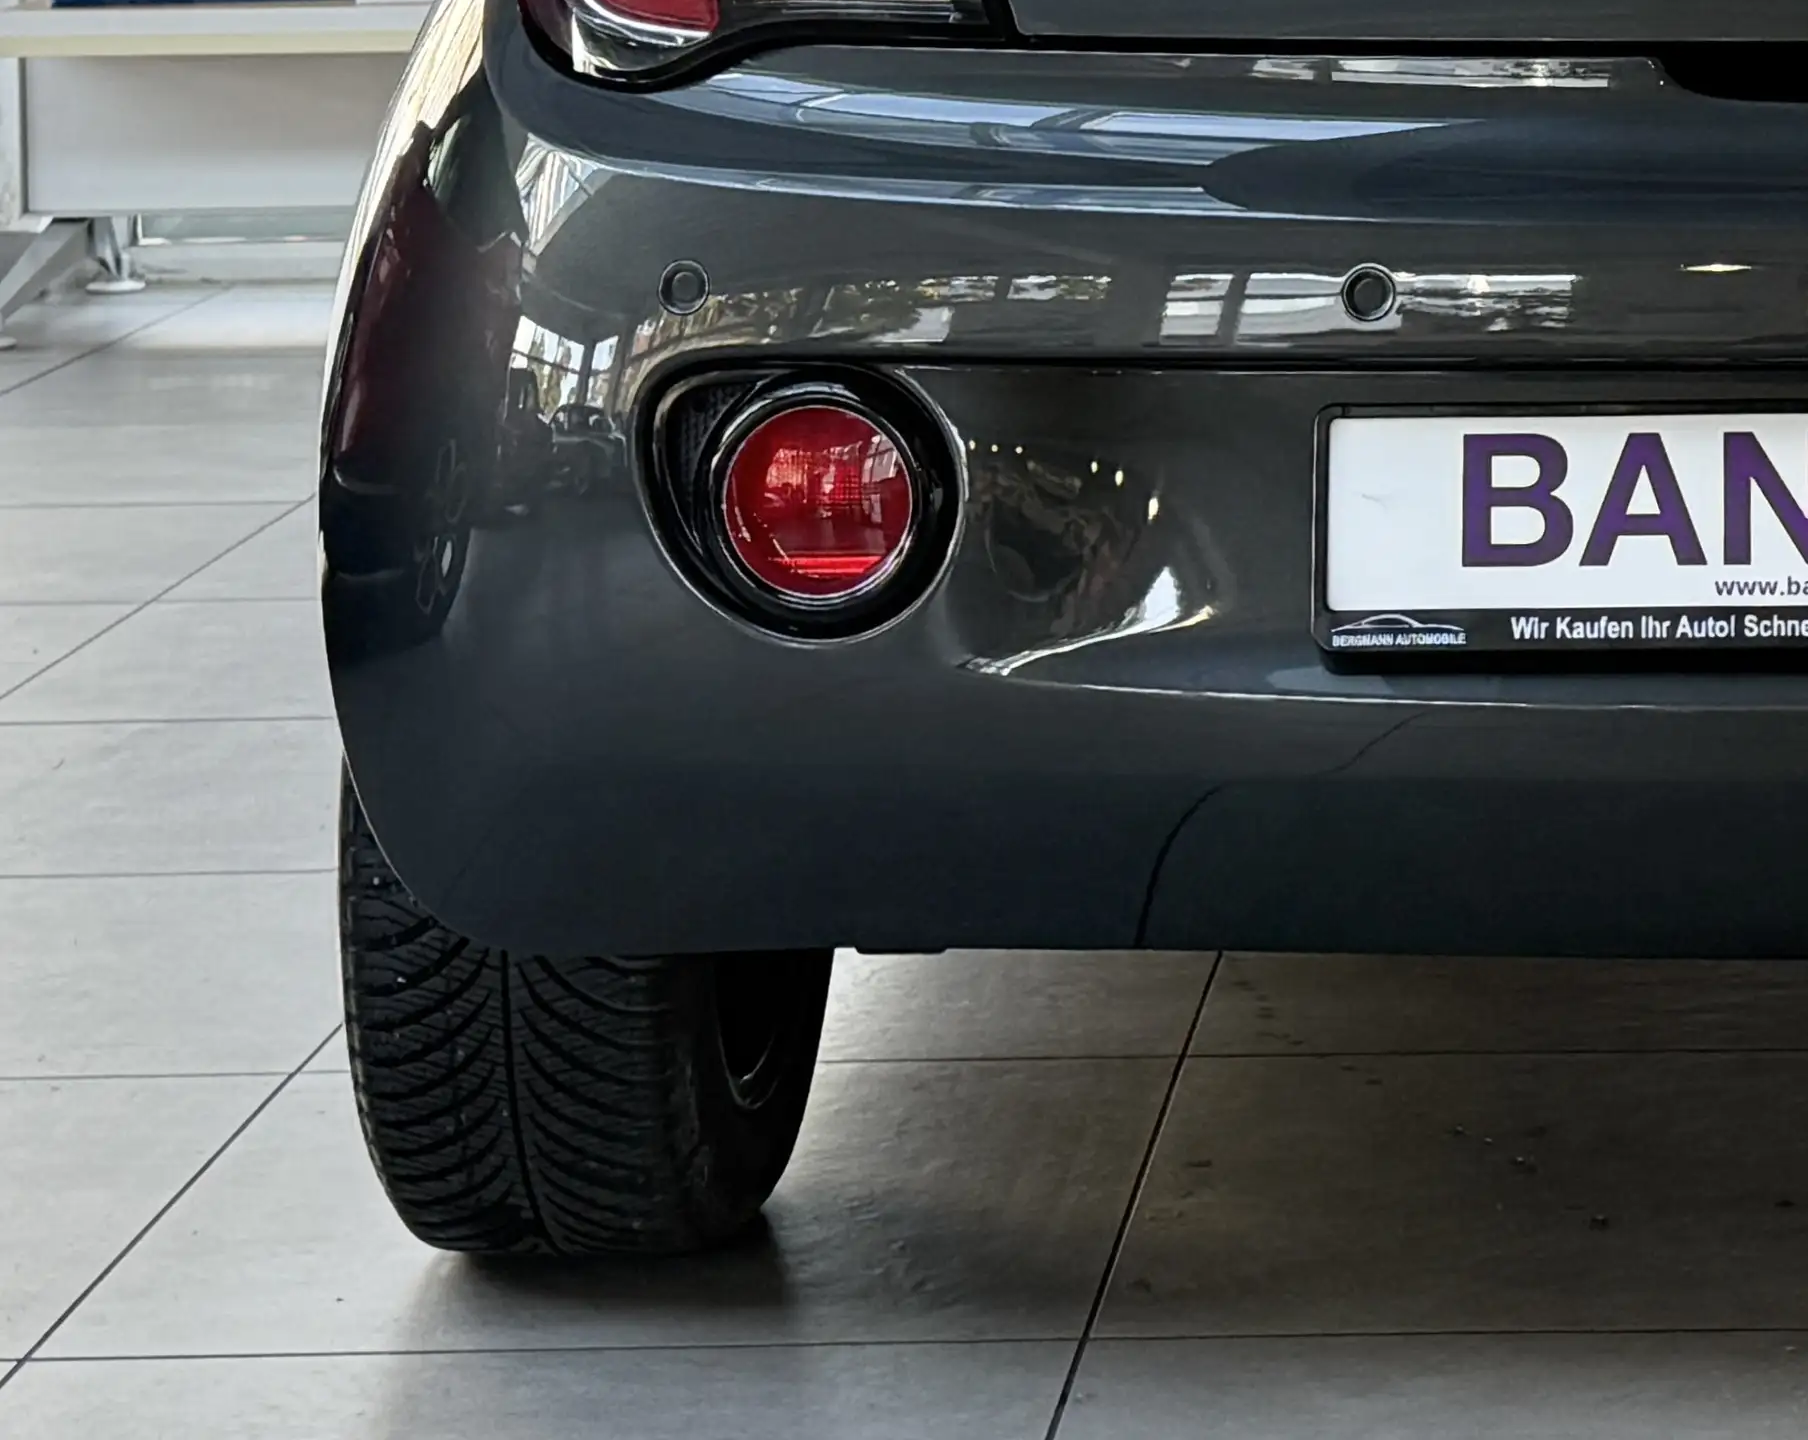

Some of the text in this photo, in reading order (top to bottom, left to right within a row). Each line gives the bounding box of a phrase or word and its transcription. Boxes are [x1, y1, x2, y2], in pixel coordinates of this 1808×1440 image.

[1510, 616, 1548, 640] Wir
[1555, 616, 1634, 640] Kaufen
[1641, 615, 1669, 639] Ihr
[1395, 632, 1467, 646] AUTOMOBILE
